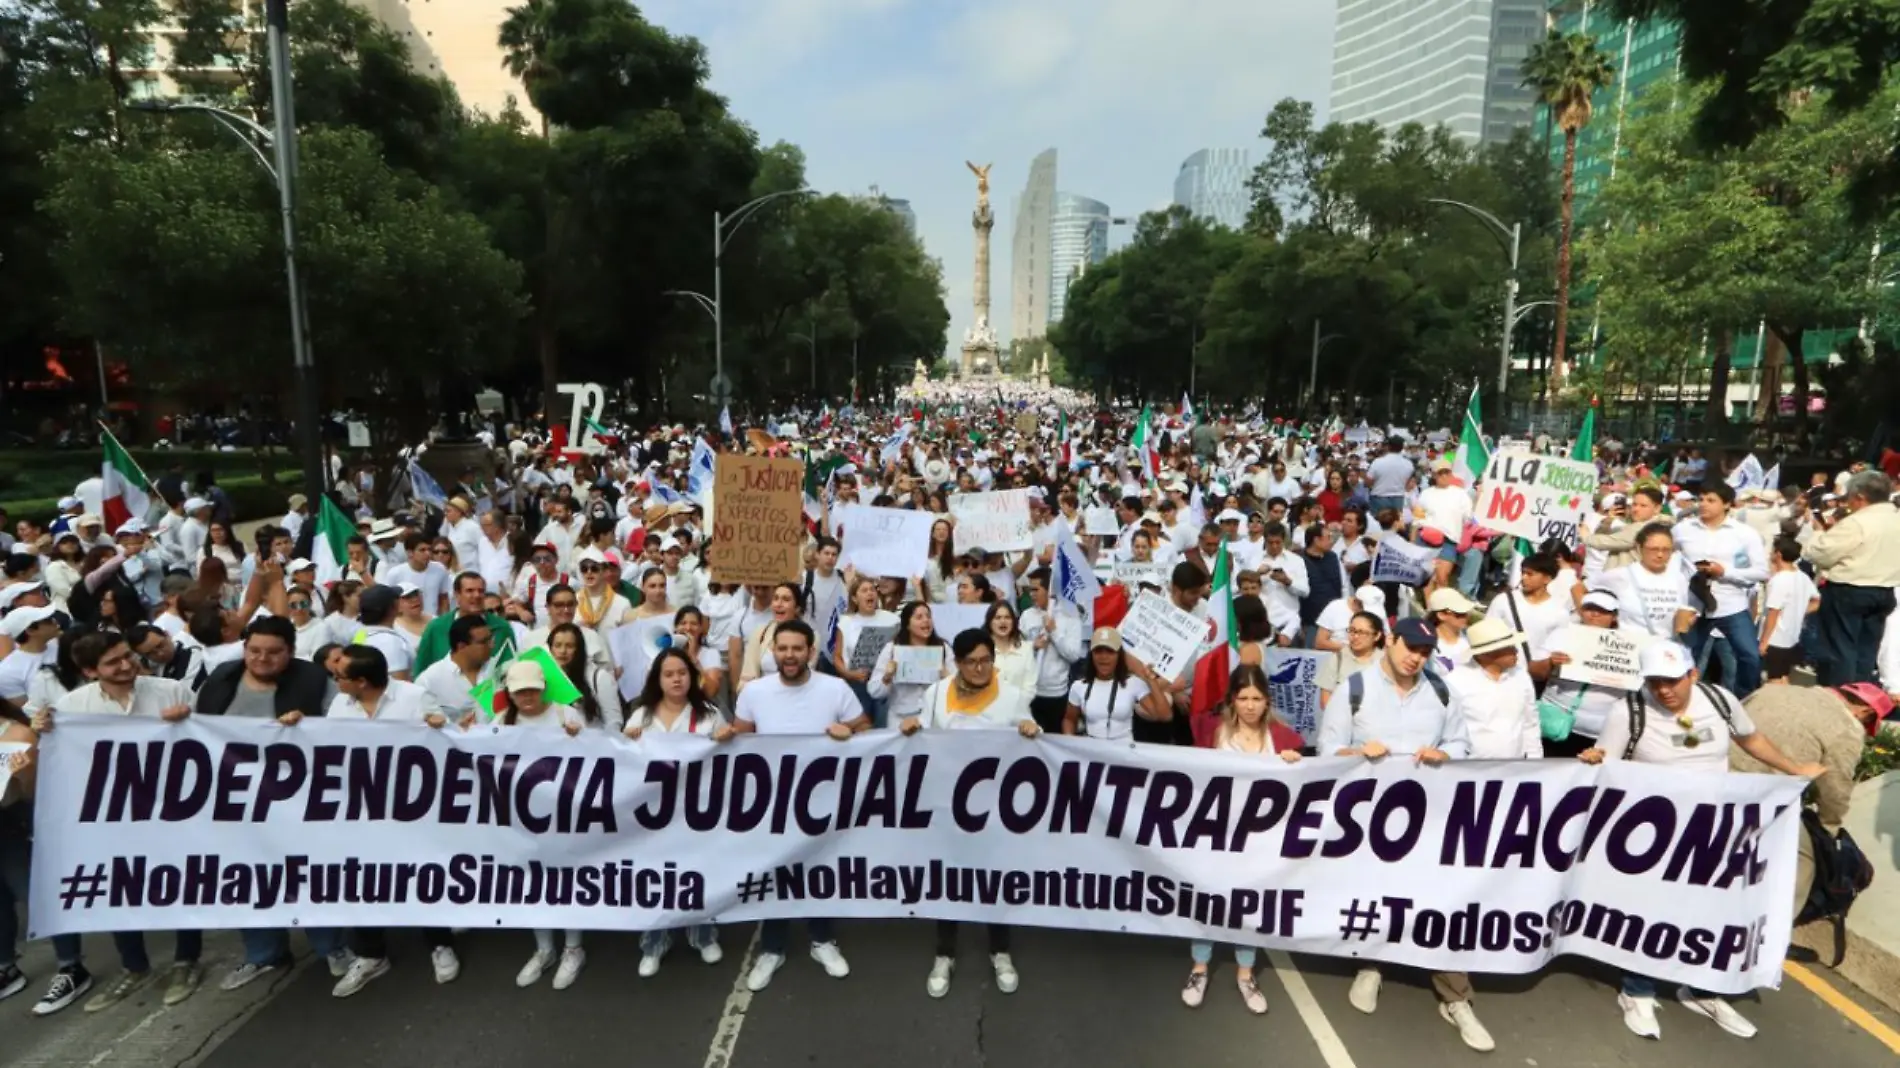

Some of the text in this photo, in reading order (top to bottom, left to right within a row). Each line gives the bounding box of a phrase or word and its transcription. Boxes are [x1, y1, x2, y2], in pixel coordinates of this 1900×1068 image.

[1486, 486, 1525, 523] NO
[714, 521, 734, 542] NO
[741, 545, 789, 568] TOGA
[79, 739, 618, 834] INDEPENDENCIA
[633, 752, 934, 836] JUDICIAL
[951, 755, 1427, 862] CONTRAPESO
[59, 853, 705, 911] #NoHayFuturoSinJusticia
[736, 855, 1304, 938] #NoHayJuventudSinPJF
